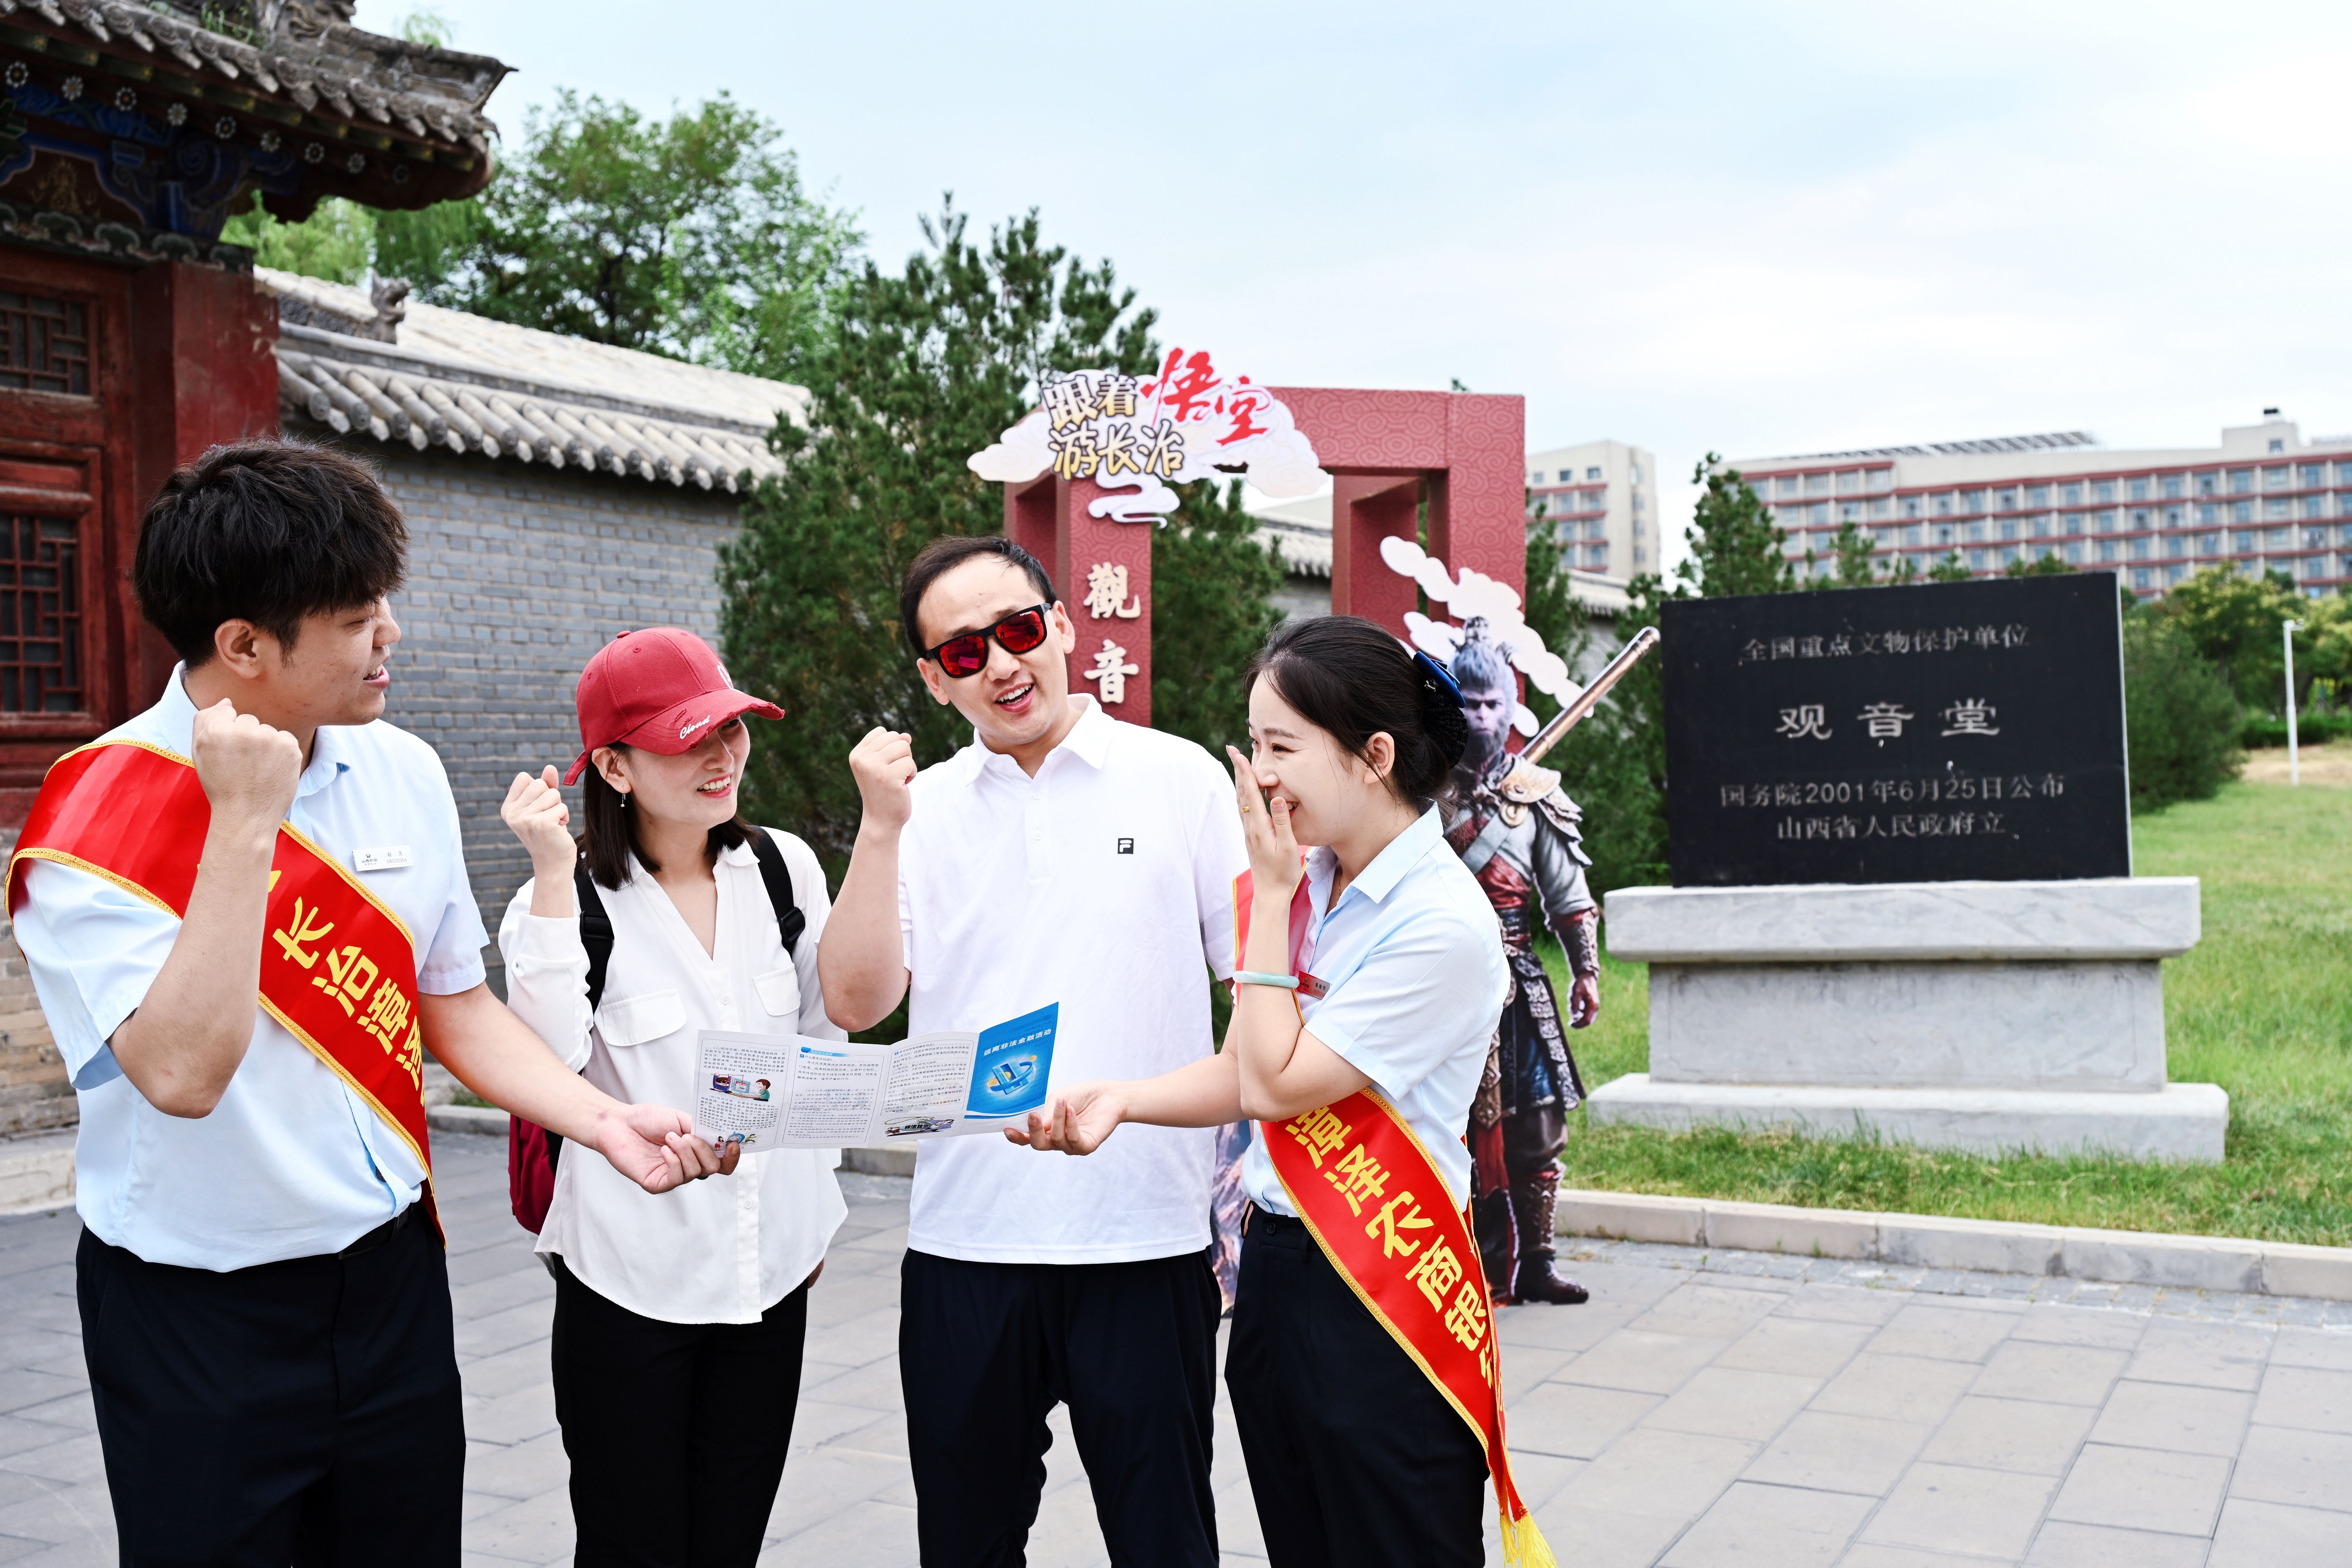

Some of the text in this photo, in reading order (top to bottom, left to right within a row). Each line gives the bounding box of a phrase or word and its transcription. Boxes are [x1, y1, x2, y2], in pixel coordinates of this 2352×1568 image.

[1048, 419, 1184, 481] 游长治
[1083, 561, 1141, 704] 觀音
[1739, 623, 2030, 662] 全国重点文物保护单位
[1775, 697, 2001, 740] 观音堂
[1720, 772, 2065, 809] 国务院2001年6月25日公布
[1777, 810, 2007, 841] 山西省人民政府立
[273, 896, 425, 1107] 长治漳泽
[983, 1028, 1052, 1056] 远离非法金融活动
